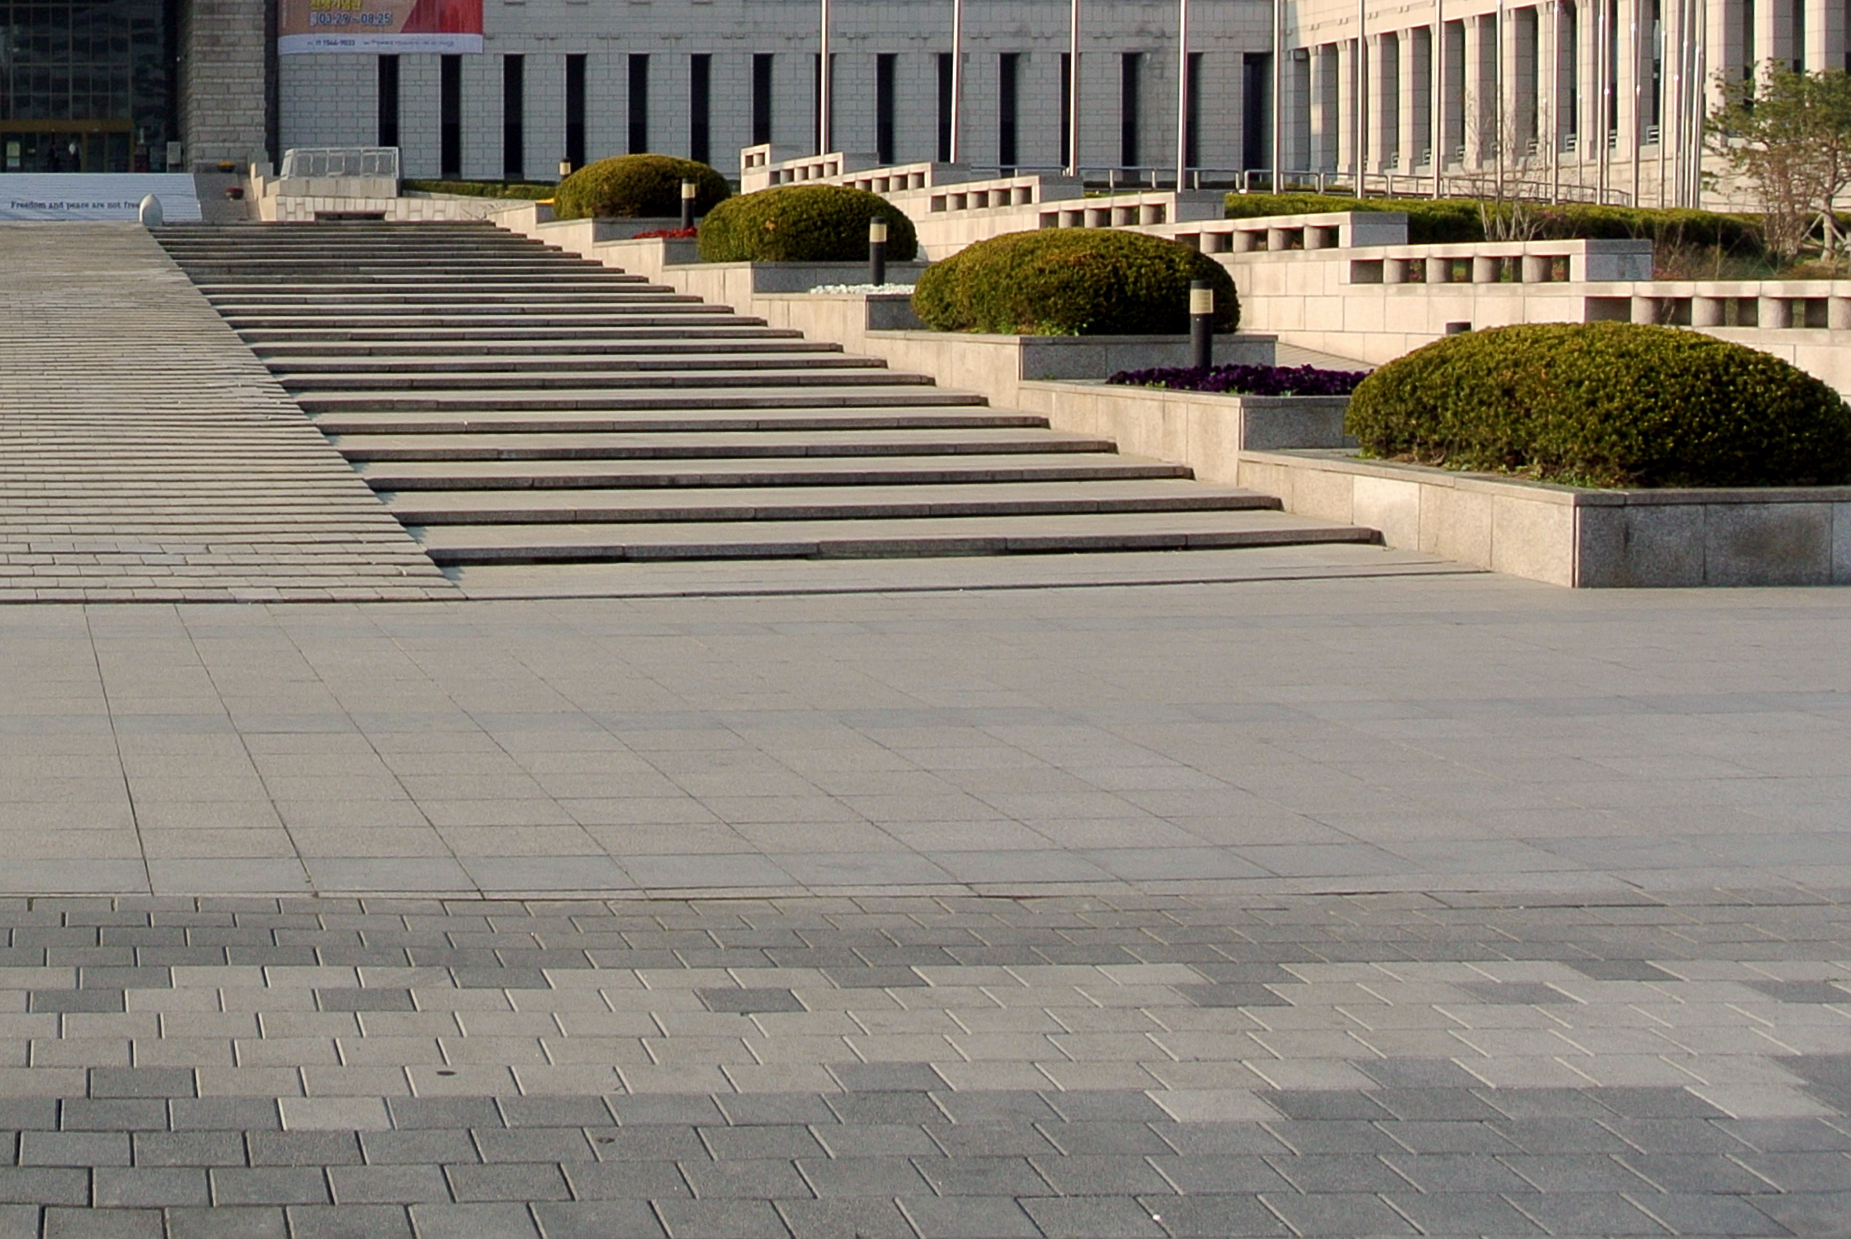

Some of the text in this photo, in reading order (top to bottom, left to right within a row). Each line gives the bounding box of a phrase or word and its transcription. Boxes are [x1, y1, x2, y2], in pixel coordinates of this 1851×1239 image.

[11, 201, 46, 209] Freedom
[49, 201, 63, 209] and
[66, 202, 89, 210] peace
[108, 201, 121, 209] not
